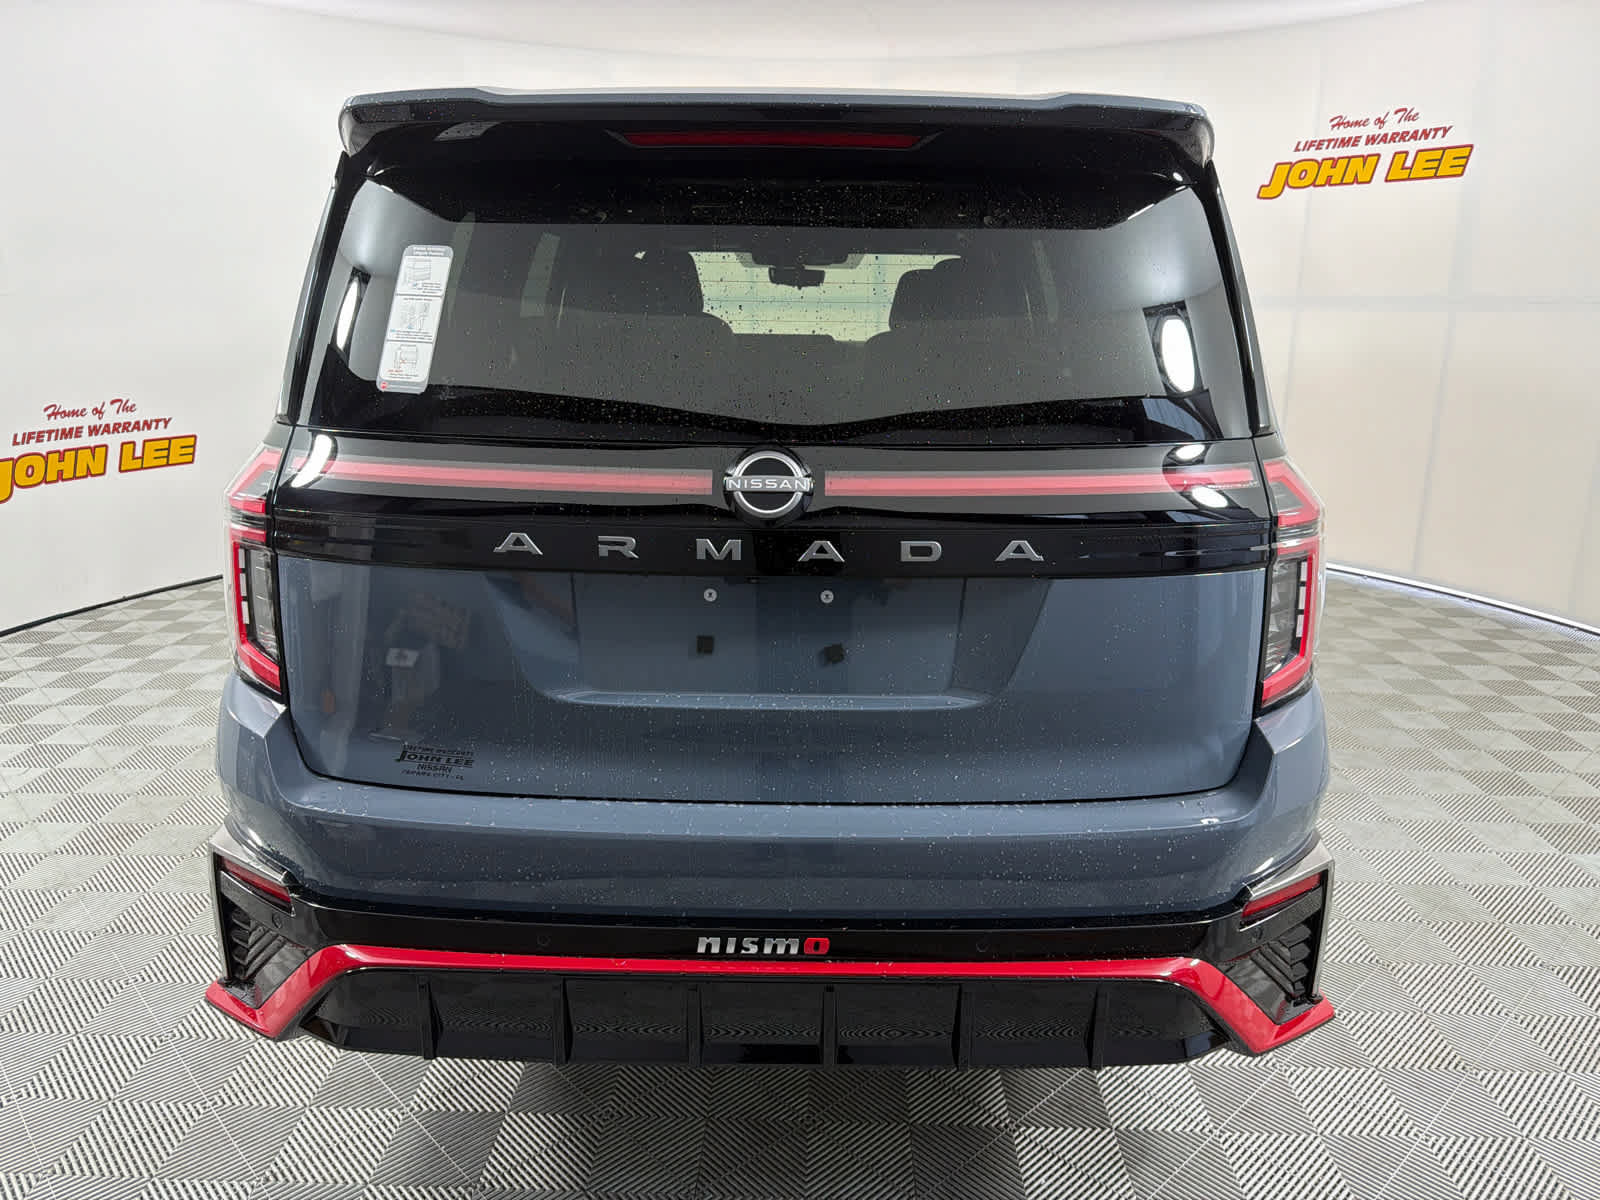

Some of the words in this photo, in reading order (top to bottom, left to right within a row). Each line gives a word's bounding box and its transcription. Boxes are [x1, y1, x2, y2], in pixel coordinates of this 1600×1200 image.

[1329, 115, 1370, 131] Home
[1374, 111, 1389, 129] of
[1394, 107, 1420, 123] The
[1293, 135, 1361, 152] LIFETIME
[1364, 125, 1453, 146] WARRANTY
[1257, 153, 1381, 200] JOHN
[1384, 144, 1474, 182] LEE
[43, 403, 88, 421] Home
[91, 402, 106, 420] of
[110, 398, 137, 414] The
[12, 426, 84, 446] LIFETIME
[88, 417, 172, 437] WARRANTY
[119, 434, 197, 473] LEE
[727, 479, 808, 489] NISSAN
[493, 532, 1044, 562] ARMADA
[395, 750, 442, 762] JOHN
[445, 757, 475, 766] LEE
[417, 763, 452, 773] NISSAN
